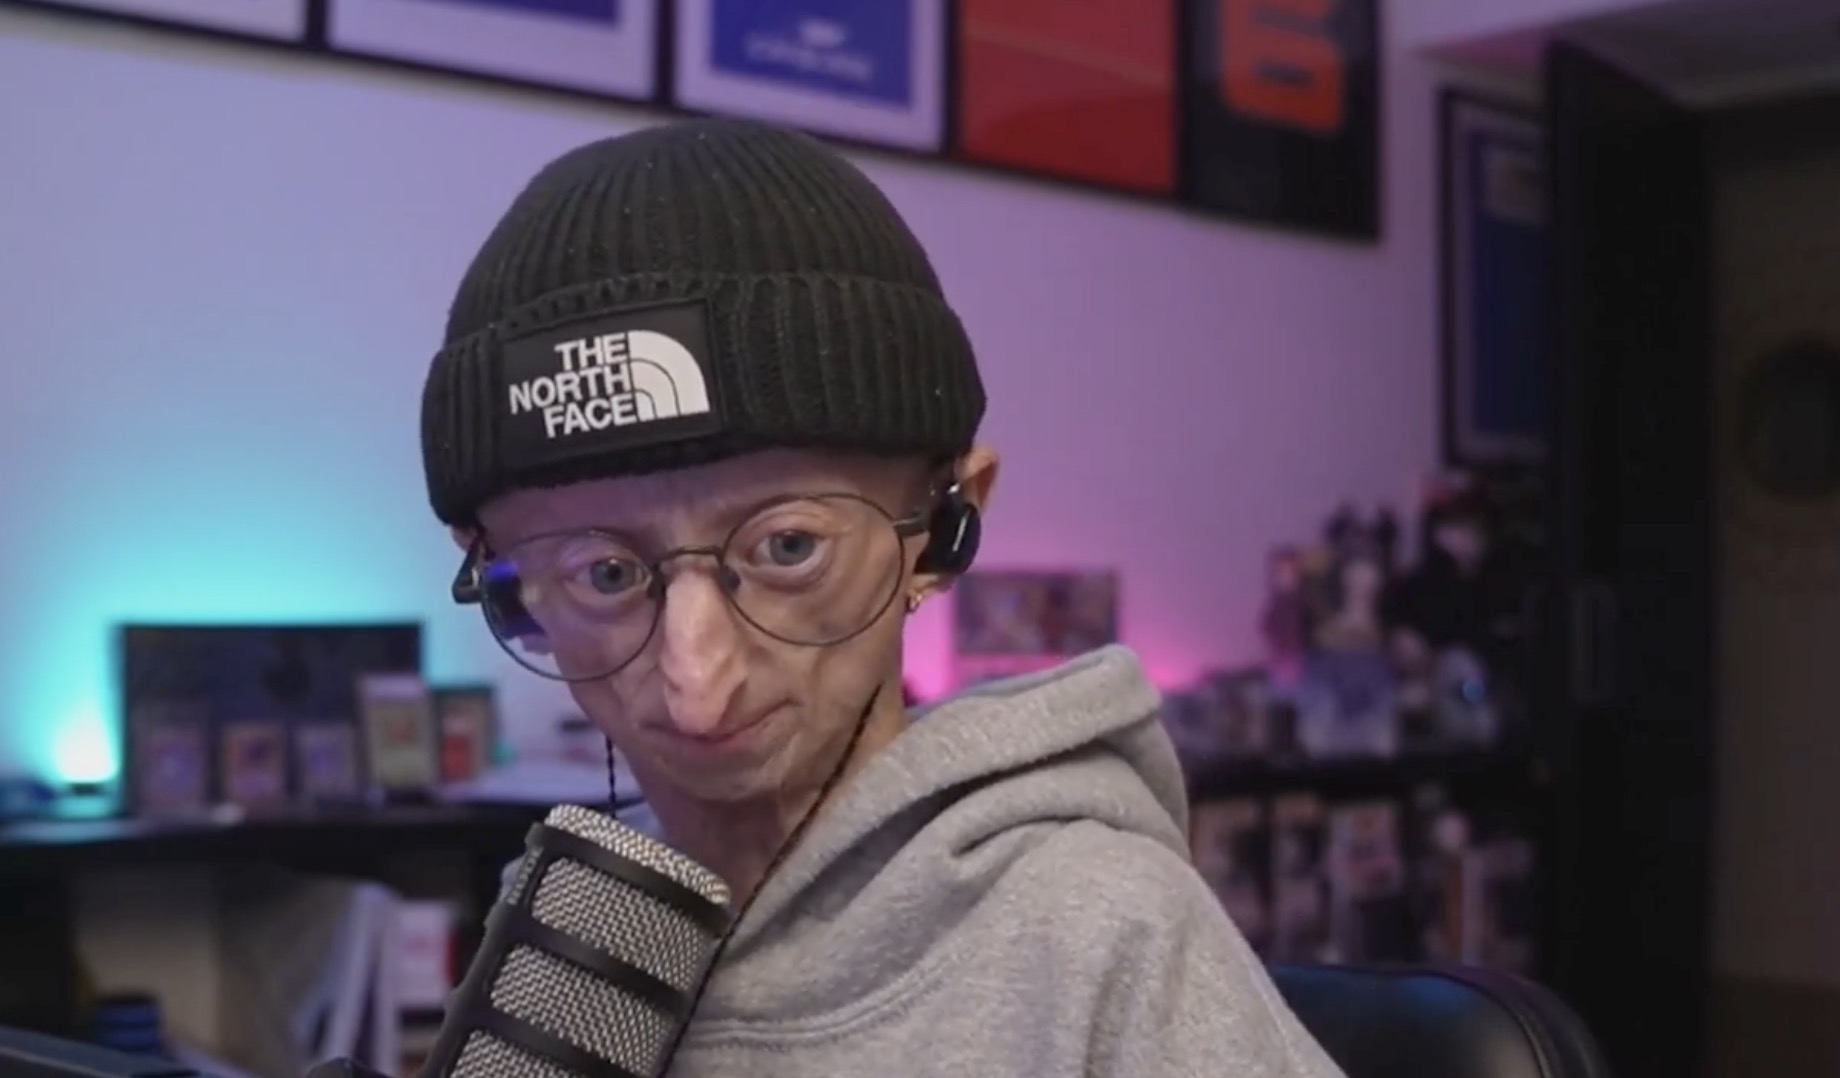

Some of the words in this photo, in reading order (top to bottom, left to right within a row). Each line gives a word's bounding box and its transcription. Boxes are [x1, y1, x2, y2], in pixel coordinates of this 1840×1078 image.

[554, 332, 627, 371] THE
[508, 363, 632, 415] NORTH
[543, 393, 637, 439] FACE
